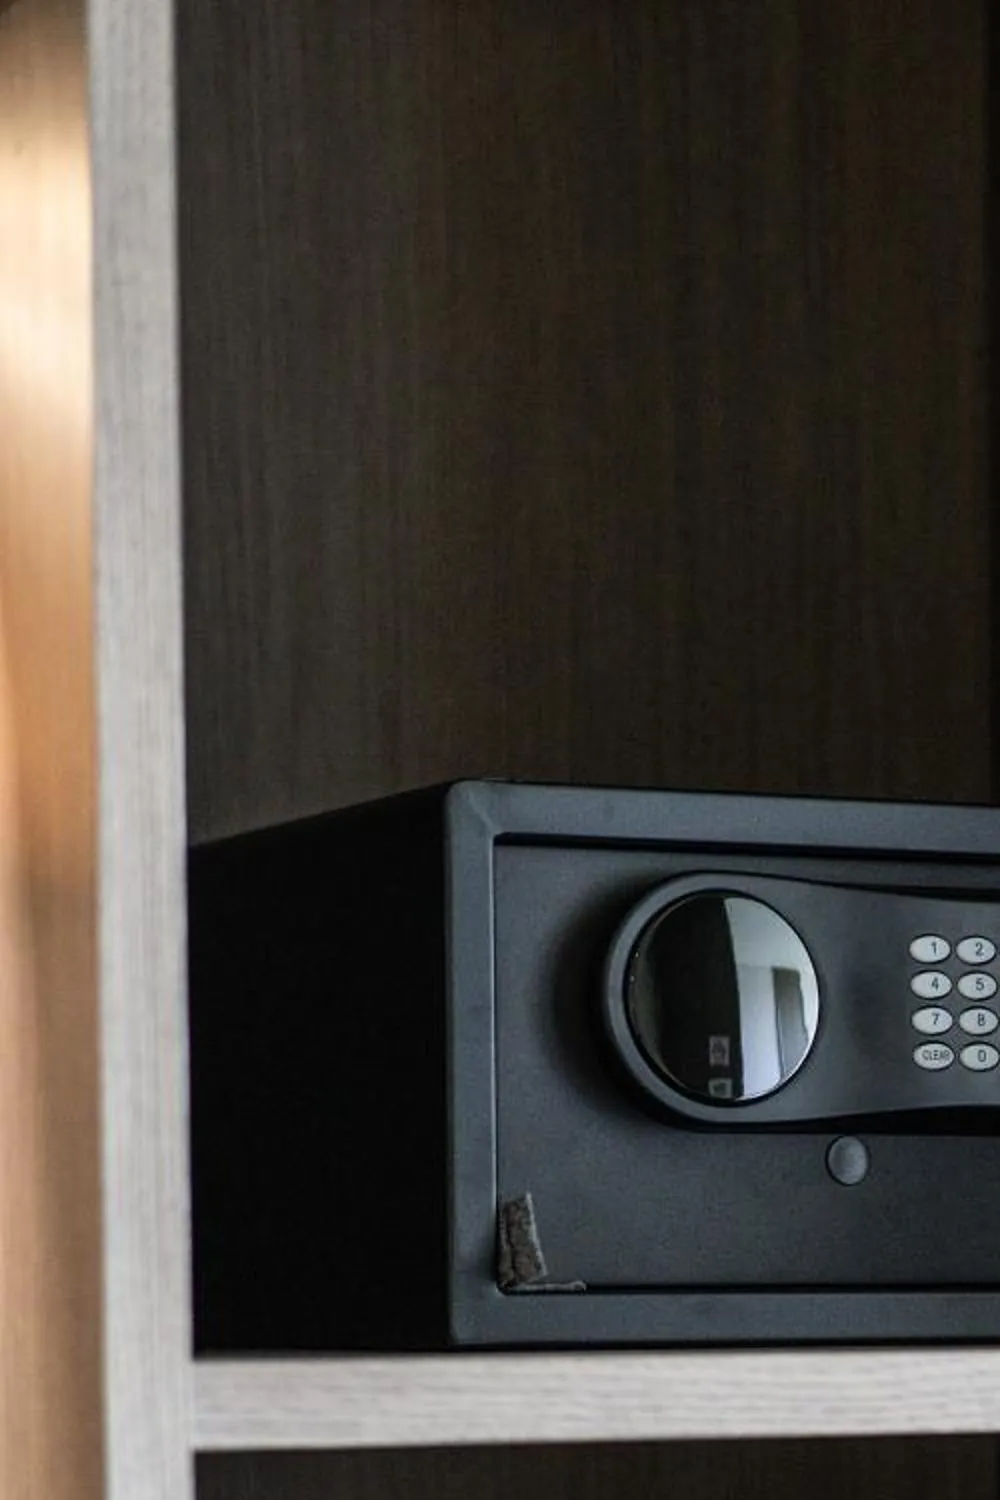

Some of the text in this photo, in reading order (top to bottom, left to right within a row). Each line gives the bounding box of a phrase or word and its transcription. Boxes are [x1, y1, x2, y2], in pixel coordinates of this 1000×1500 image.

[931, 942, 937, 954] 1
[975, 942, 983, 956] 2
[931, 977, 939, 991] 4
[975, 977, 984, 991] 5
[932, 1013, 940, 1025] 7
[977, 1013, 986, 1027] 8
[921, 1050, 950, 1062] CLEAR
[977, 1050, 986, 1062] 0
